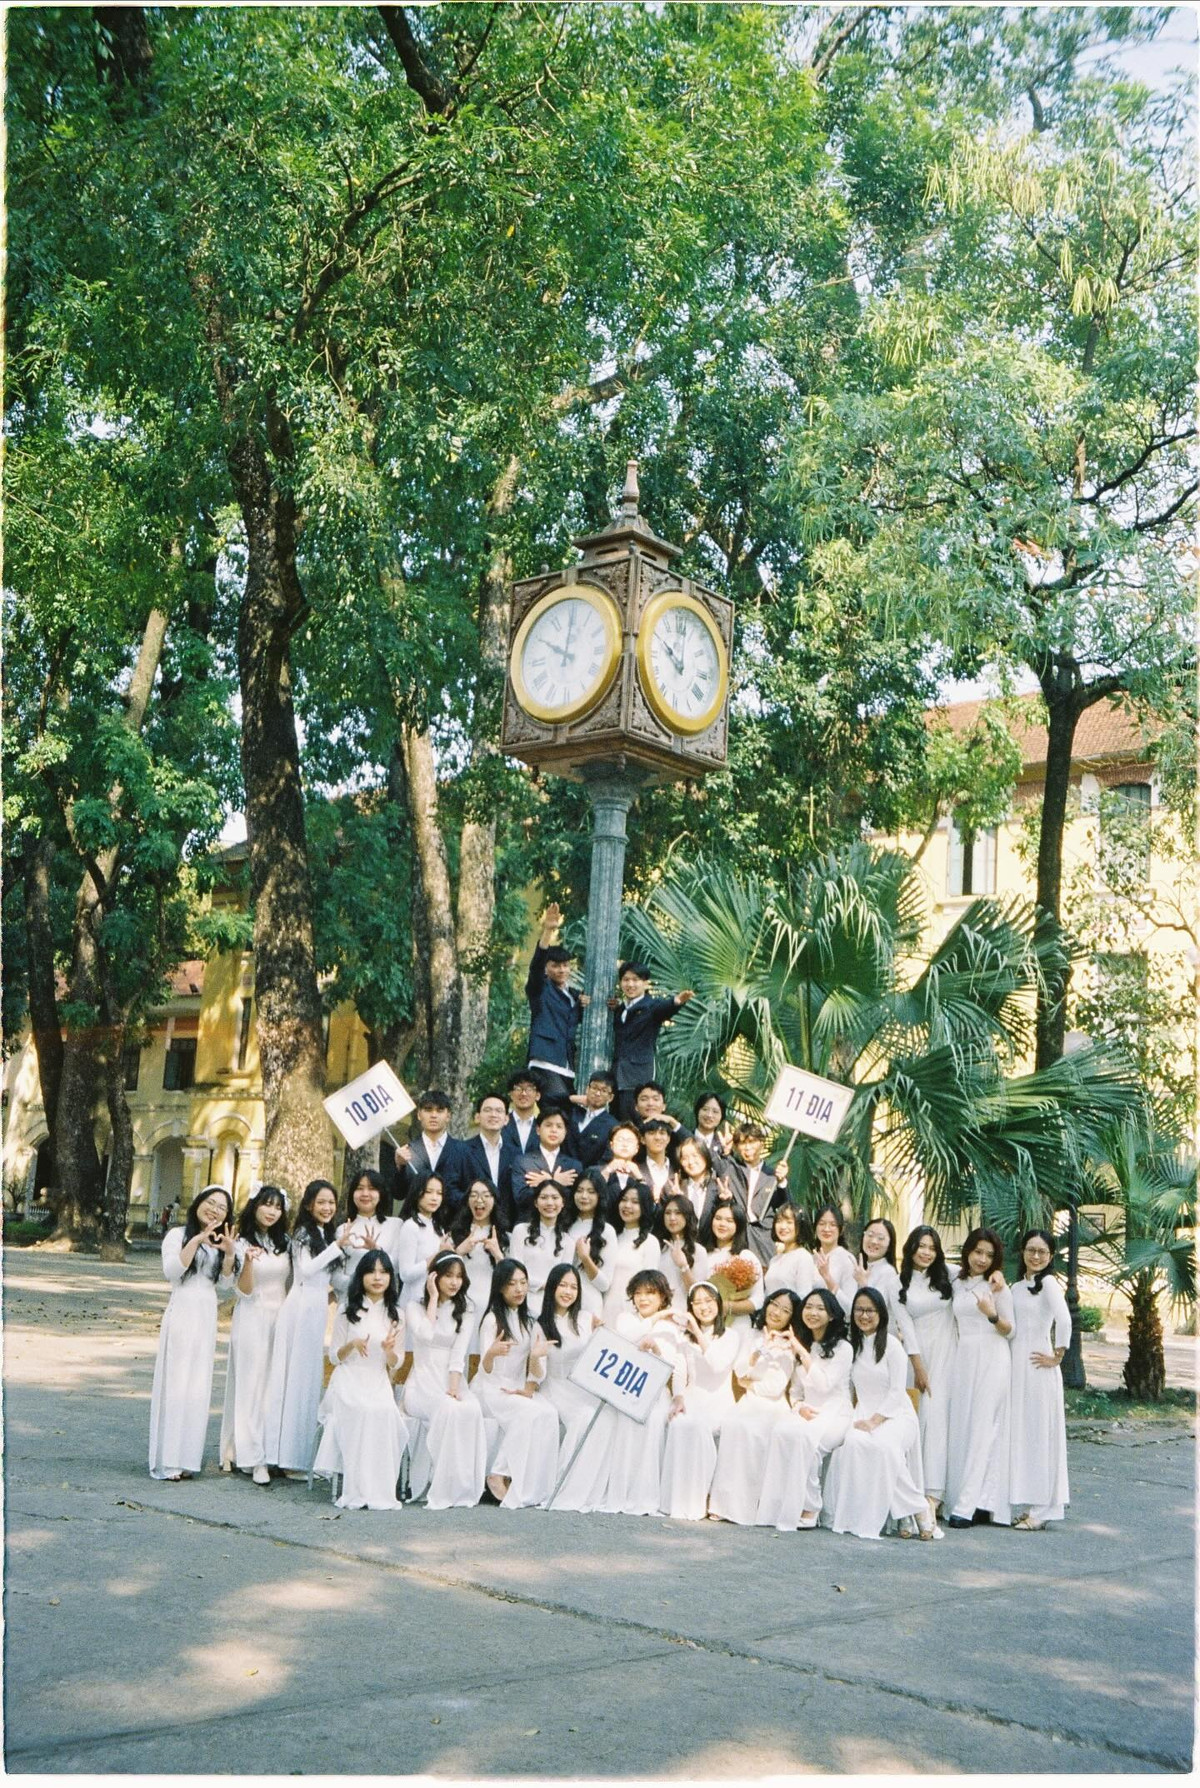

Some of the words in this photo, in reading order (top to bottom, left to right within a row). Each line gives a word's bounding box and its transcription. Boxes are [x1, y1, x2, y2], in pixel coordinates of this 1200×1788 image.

[345, 1101, 368, 1126] 10
[362, 1084, 394, 1114] ĐỊA
[786, 1087, 805, 1111] 11
[806, 1094, 834, 1124] ĐỊA
[593, 1348, 619, 1379] 12
[613, 1360, 649, 1398] ĐỊA
